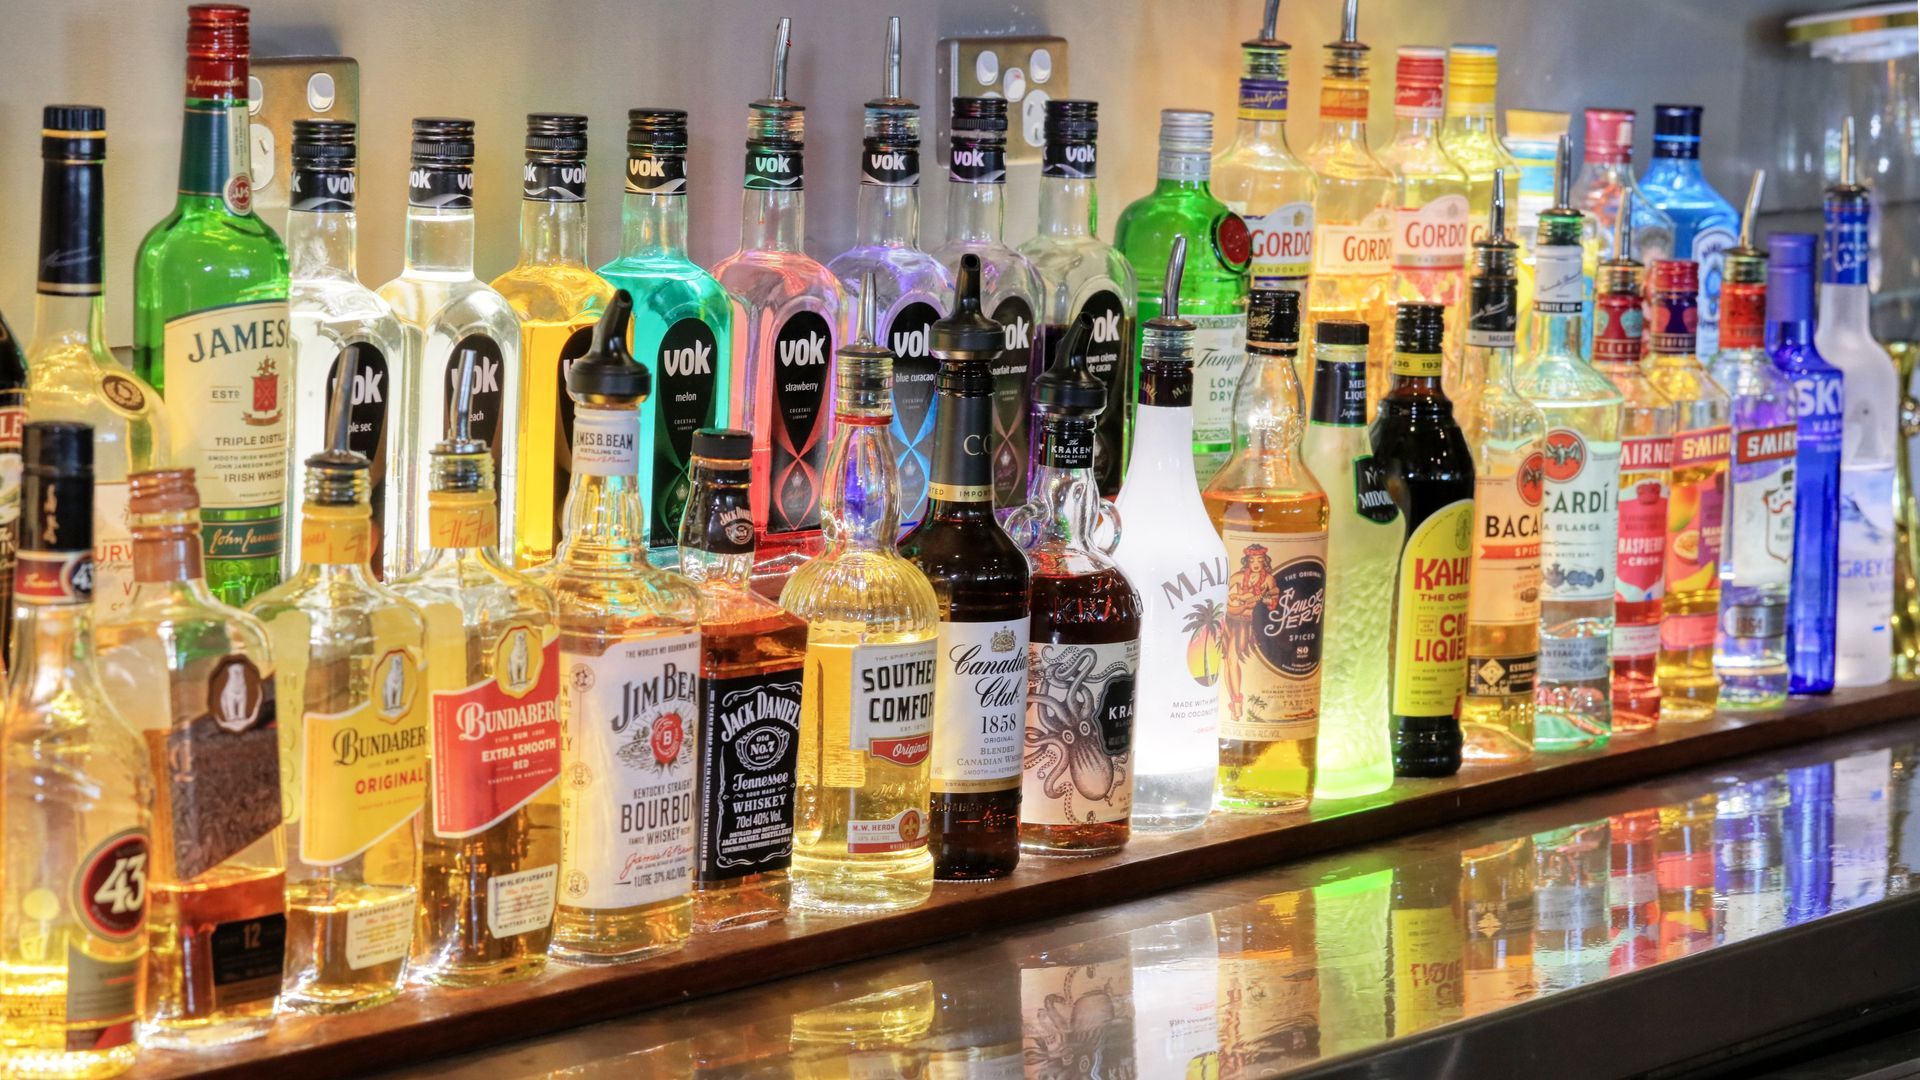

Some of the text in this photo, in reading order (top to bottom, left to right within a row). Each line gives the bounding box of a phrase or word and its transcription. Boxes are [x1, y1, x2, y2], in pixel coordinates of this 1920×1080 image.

[871, 151, 906, 170] vok
[953, 148, 984, 166] vok
[1065, 145, 1095, 163] vok
[630, 156, 665, 177] vok
[755, 154, 790, 173] vok
[1003, 316, 1030, 350] ok
[1092, 309, 1120, 343] ok
[780, 331, 826, 367] vok
[664, 340, 711, 377] vok
[452, 356, 498, 394] ok
[896, 371, 909, 382] blue
[333, 366, 382, 405] ok
[785, 382, 819, 392] strawberry
[675, 392, 696, 402] melon
[1210, 391, 1233, 401] DRY
[360, 422, 372, 432] sec
[215, 436, 256, 446] TRIPLE
[606, 433, 633, 451] BEAM
[1051, 446, 1090, 455] KRAKEN
[224, 471, 255, 482] IRISH
[210, 529, 243, 554] John
[1269, 588, 1324, 622] SAILOR
[1419, 593, 1445, 602] THE
[1264, 590, 1324, 636] JERRY
[1297, 646, 1309, 654] 80
[611, 675, 660, 734] JIM
[720, 700, 757, 742] JACK
[981, 713, 1016, 734] 1858
[513, 732, 529, 740] RUM
[481, 738, 556, 762] EXTRA SMOOTH
[751, 741, 775, 756] No.7
[893, 740, 929, 758] Original
[980, 746, 1015, 755] BLENDED
[513, 759, 529, 770] RED
[957, 758, 1003, 766] CANADIAN
[355, 768, 423, 795] ORIGINAL
[633, 778, 693, 799] KENTUCKY STRAIGHT
[733, 772, 788, 791] Tennessee
[761, 788, 776, 796] MASH
[733, 794, 787, 814] WHISKEY
[736, 815, 752, 829] 70cl
[753, 811, 769, 825] 40%
[762, 824, 780, 833] BOTTLED
[853, 823, 896, 831] M.W. HERON
[647, 827, 680, 845] WHISKEY
[721, 827, 792, 847] JACK DANIEL DISTILLERY
[94, 853, 147, 915] 43
[243, 921, 262, 949] 12
